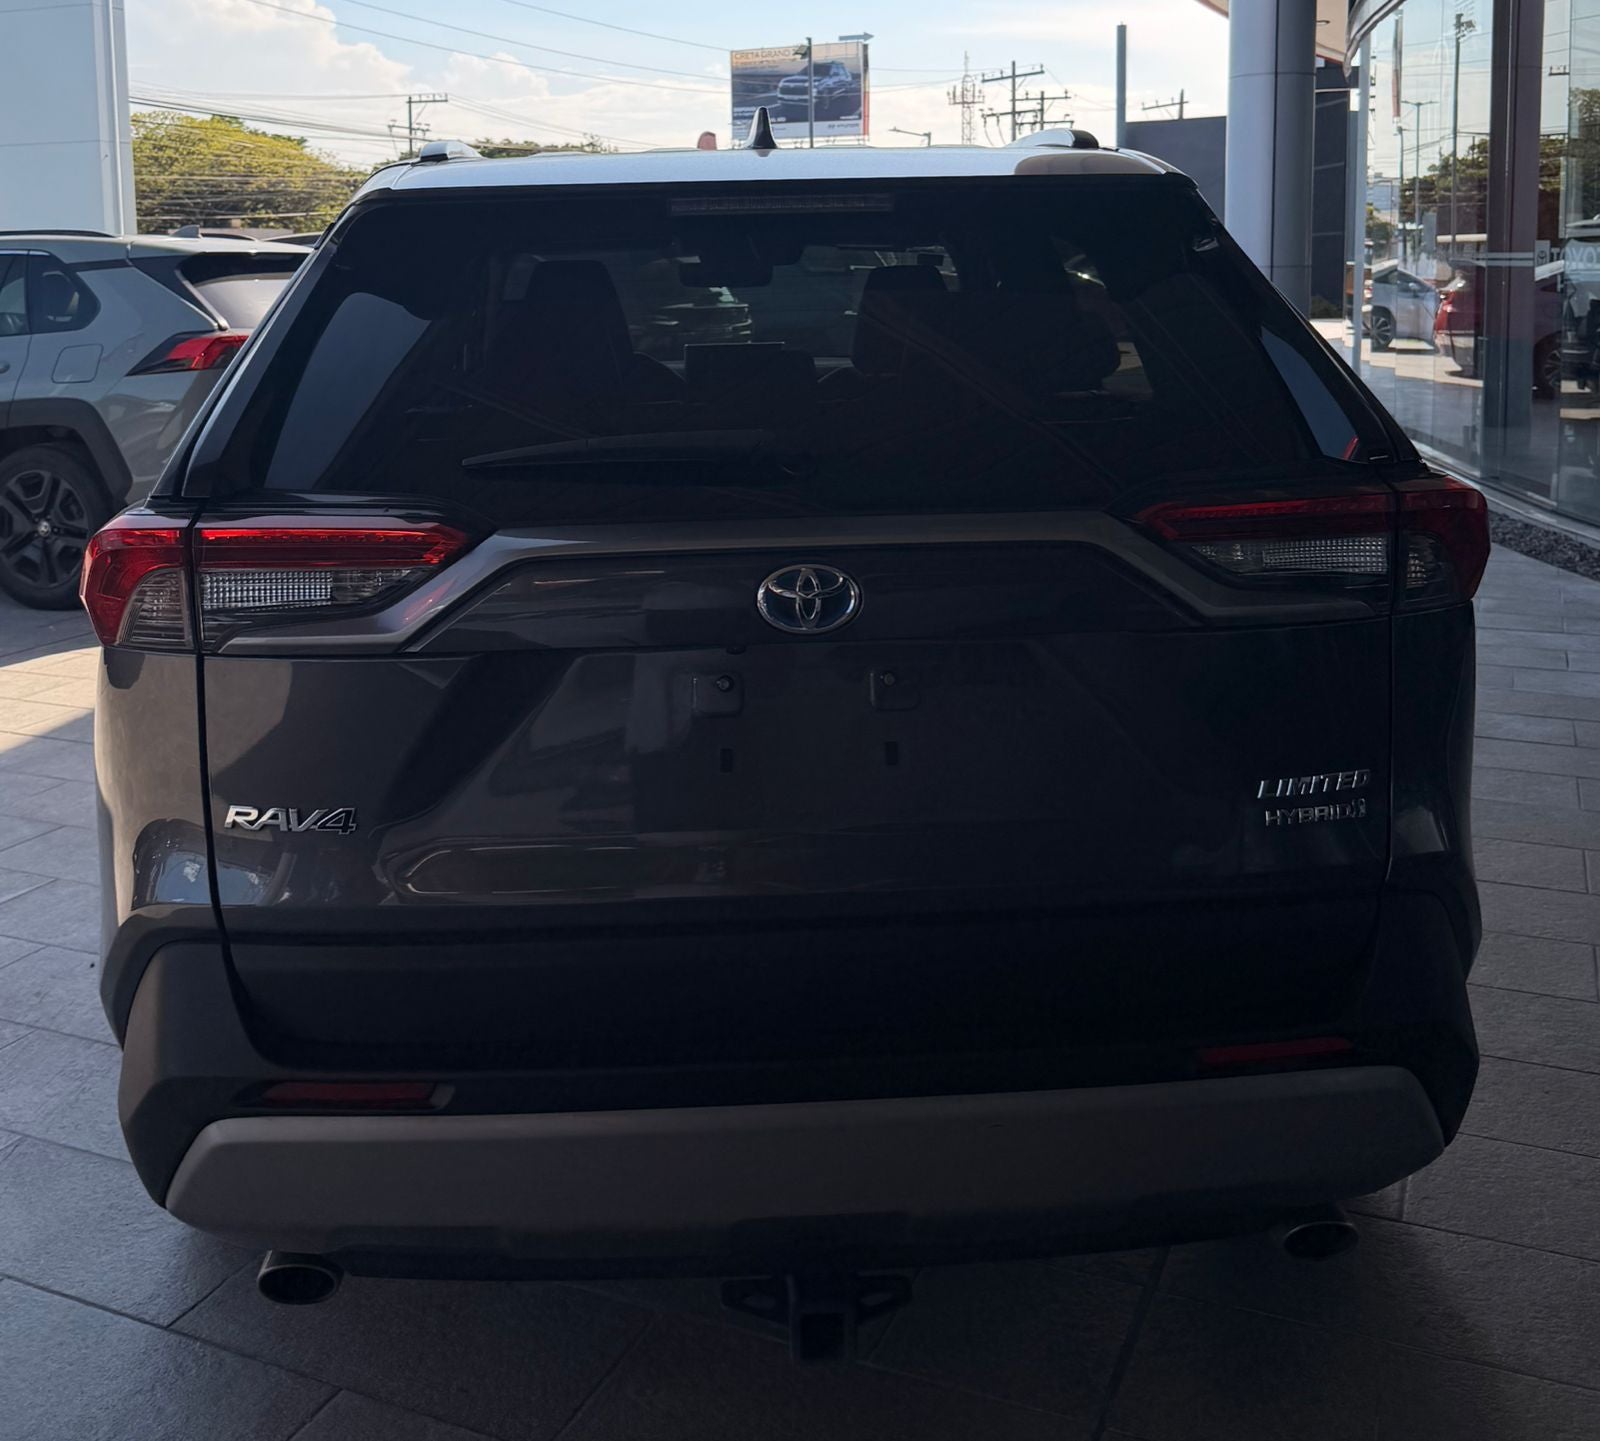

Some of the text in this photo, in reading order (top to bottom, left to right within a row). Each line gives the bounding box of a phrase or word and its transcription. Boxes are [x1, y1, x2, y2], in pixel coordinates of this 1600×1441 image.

[1550, 246, 1600, 269] TOYO
[1257, 769, 1370, 799] LIMITED
[224, 804, 357, 835] RAV4
